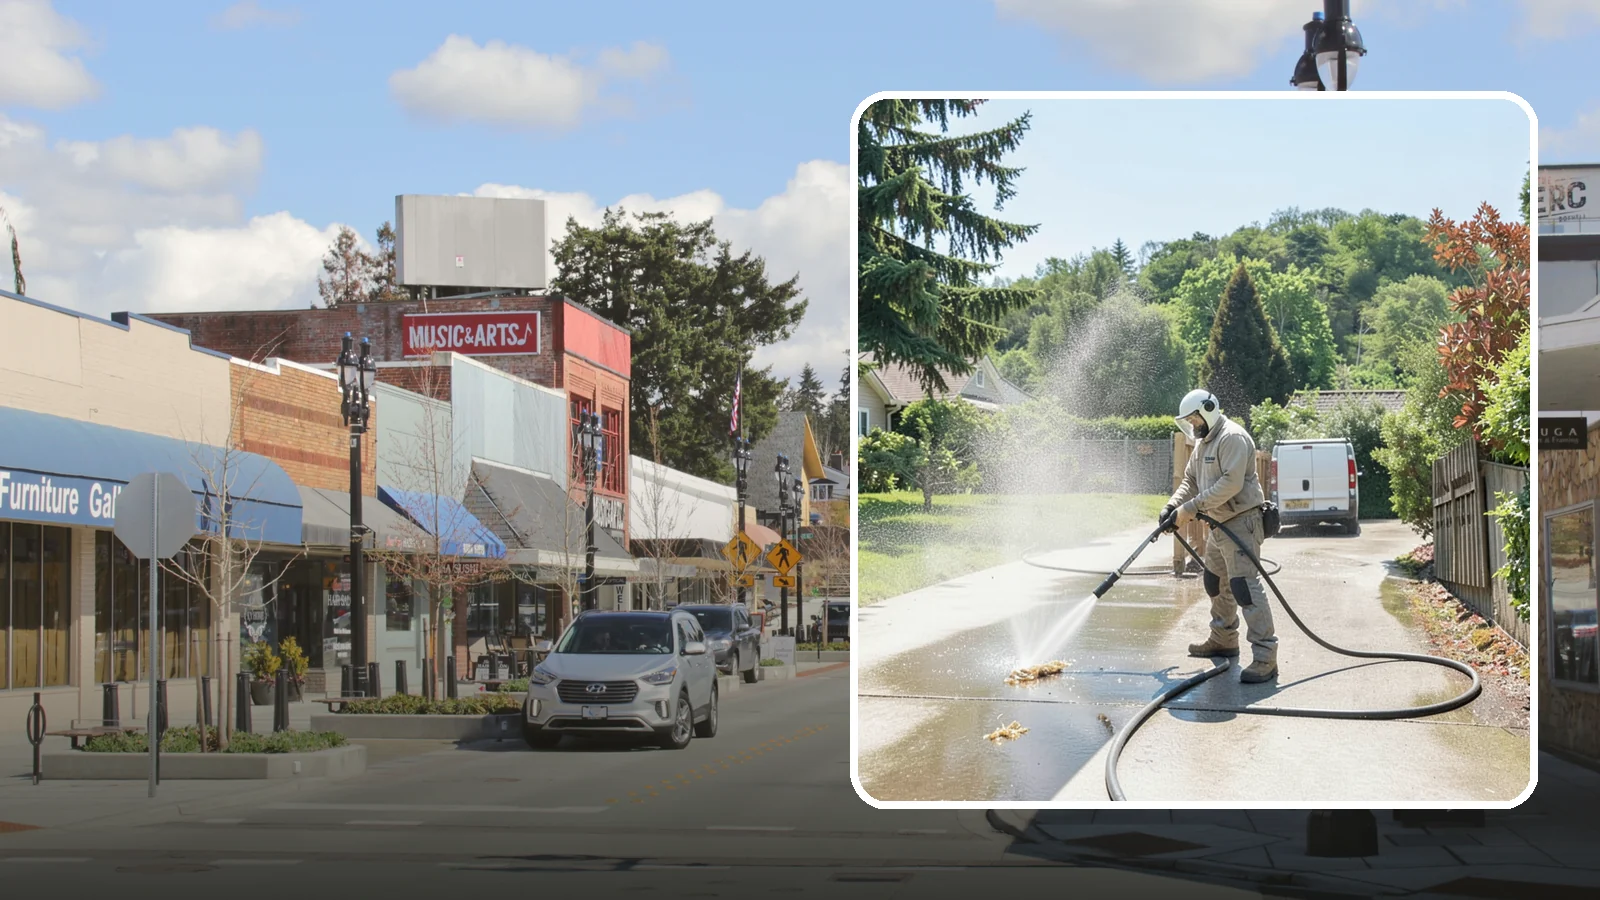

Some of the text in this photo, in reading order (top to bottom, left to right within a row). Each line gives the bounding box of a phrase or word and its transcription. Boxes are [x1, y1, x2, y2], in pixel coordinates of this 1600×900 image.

[409, 322, 519, 348] MUSIC&ARTS
[0, 471, 122, 519] Furniture Gal
[453, 563, 479, 574] SUSHI
